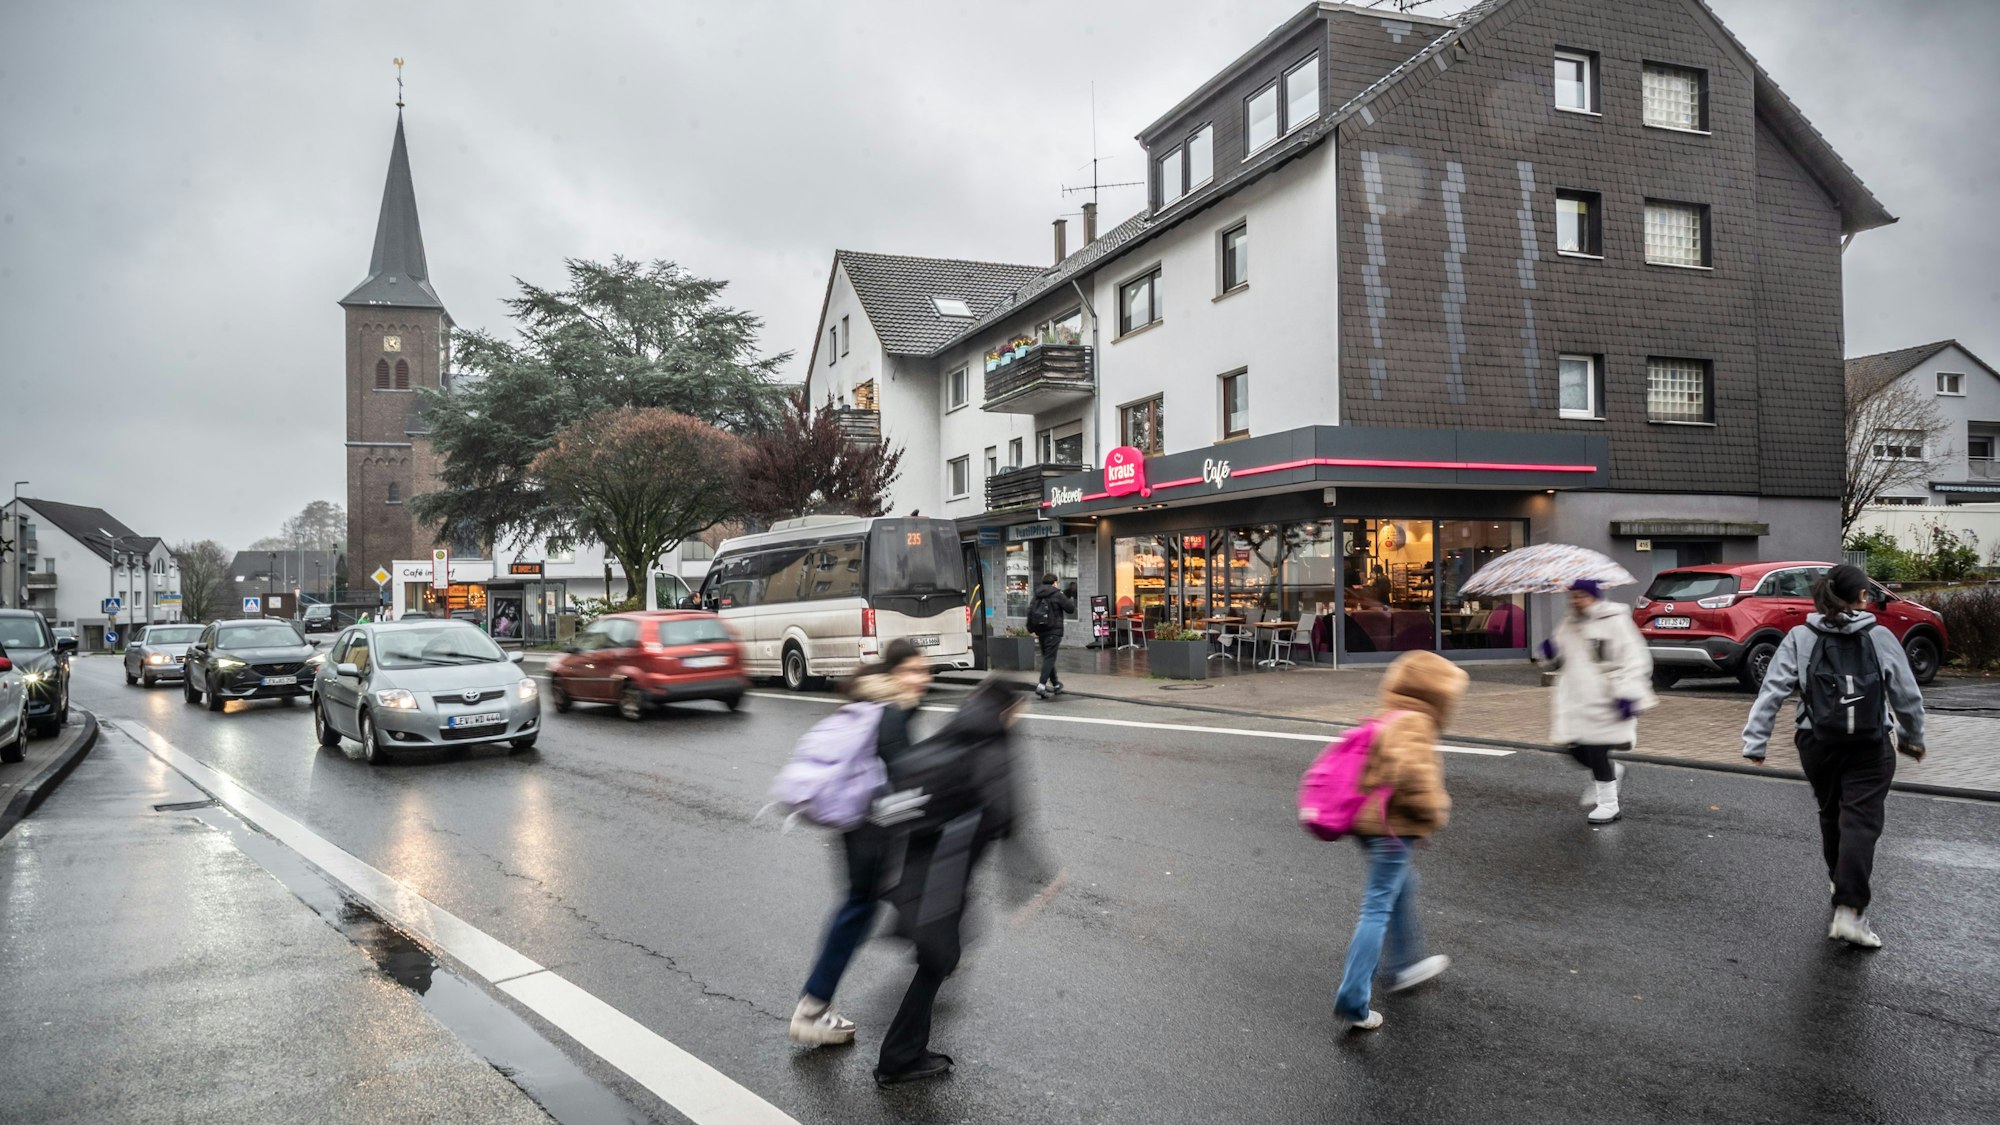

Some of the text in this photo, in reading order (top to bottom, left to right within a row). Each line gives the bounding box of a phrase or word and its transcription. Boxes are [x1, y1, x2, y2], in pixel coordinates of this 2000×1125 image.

[1108, 463, 1135, 481] kraus
[1203, 458, 1231, 489] Café
[907, 533, 921, 545] 235
[403, 568, 423, 578] Café
